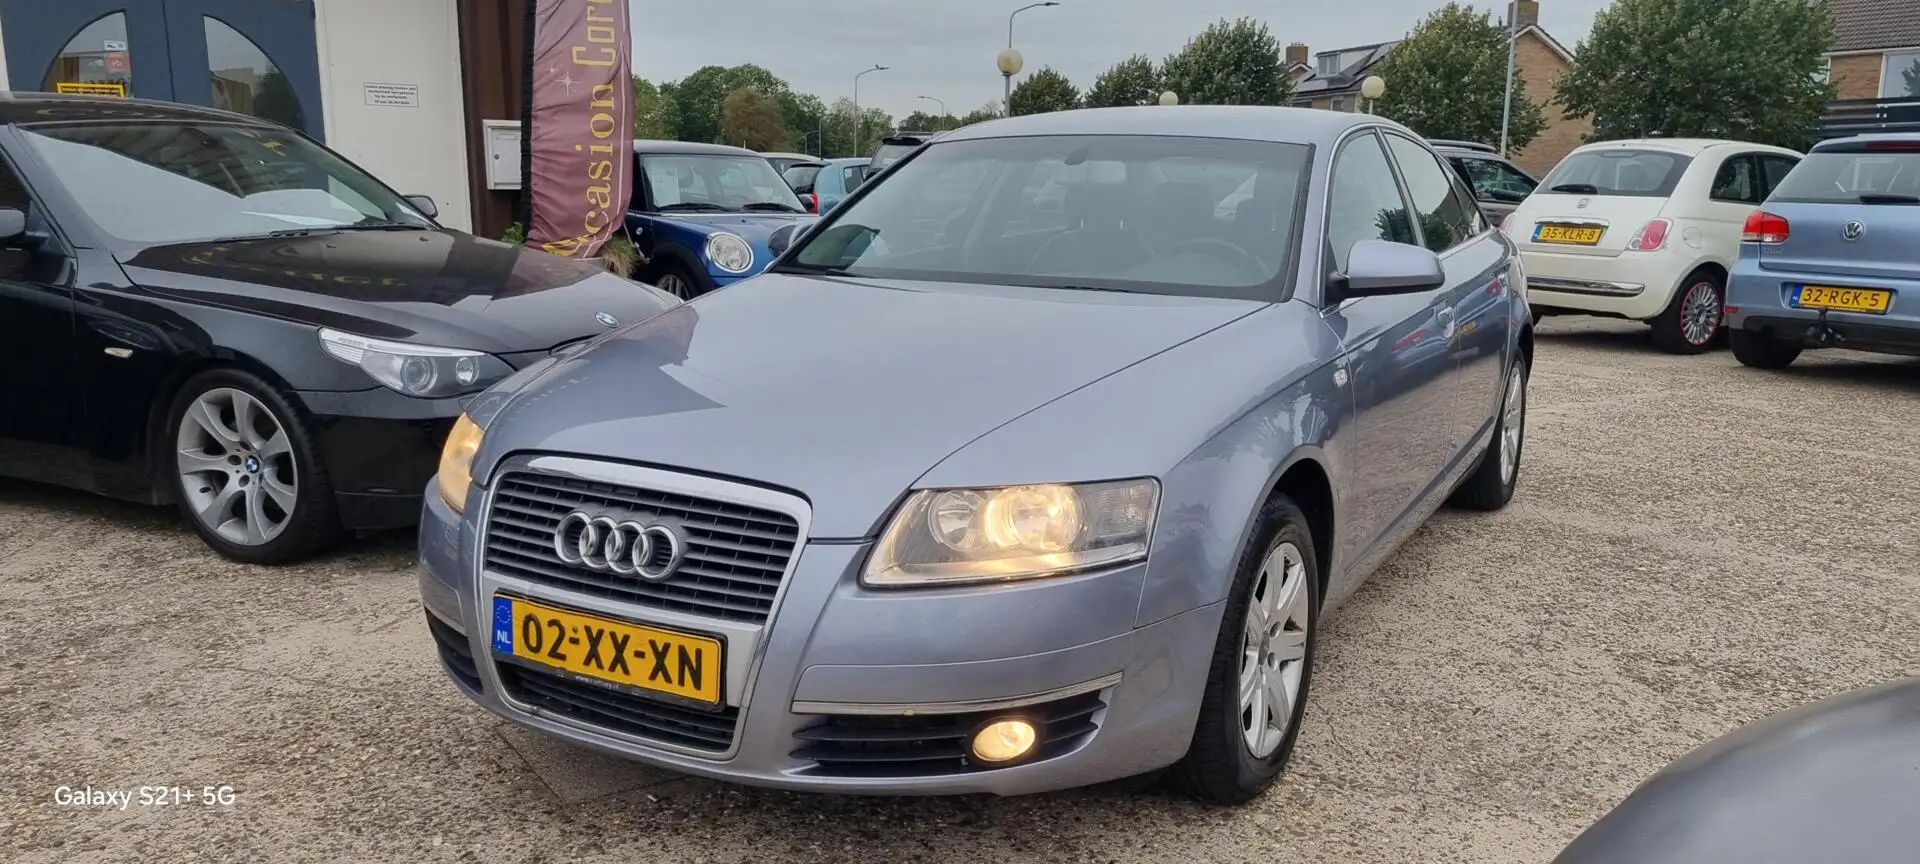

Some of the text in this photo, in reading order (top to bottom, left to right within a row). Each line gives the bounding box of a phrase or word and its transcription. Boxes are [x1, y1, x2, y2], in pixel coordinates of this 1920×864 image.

[572, 0, 616, 66] Cor
[1542, 228, 1596, 240] 35-KLR-8
[1803, 288, 1880, 307] 32-RGK-5
[496, 629, 512, 644] NL
[522, 613, 703, 691] 02-XX-XN
